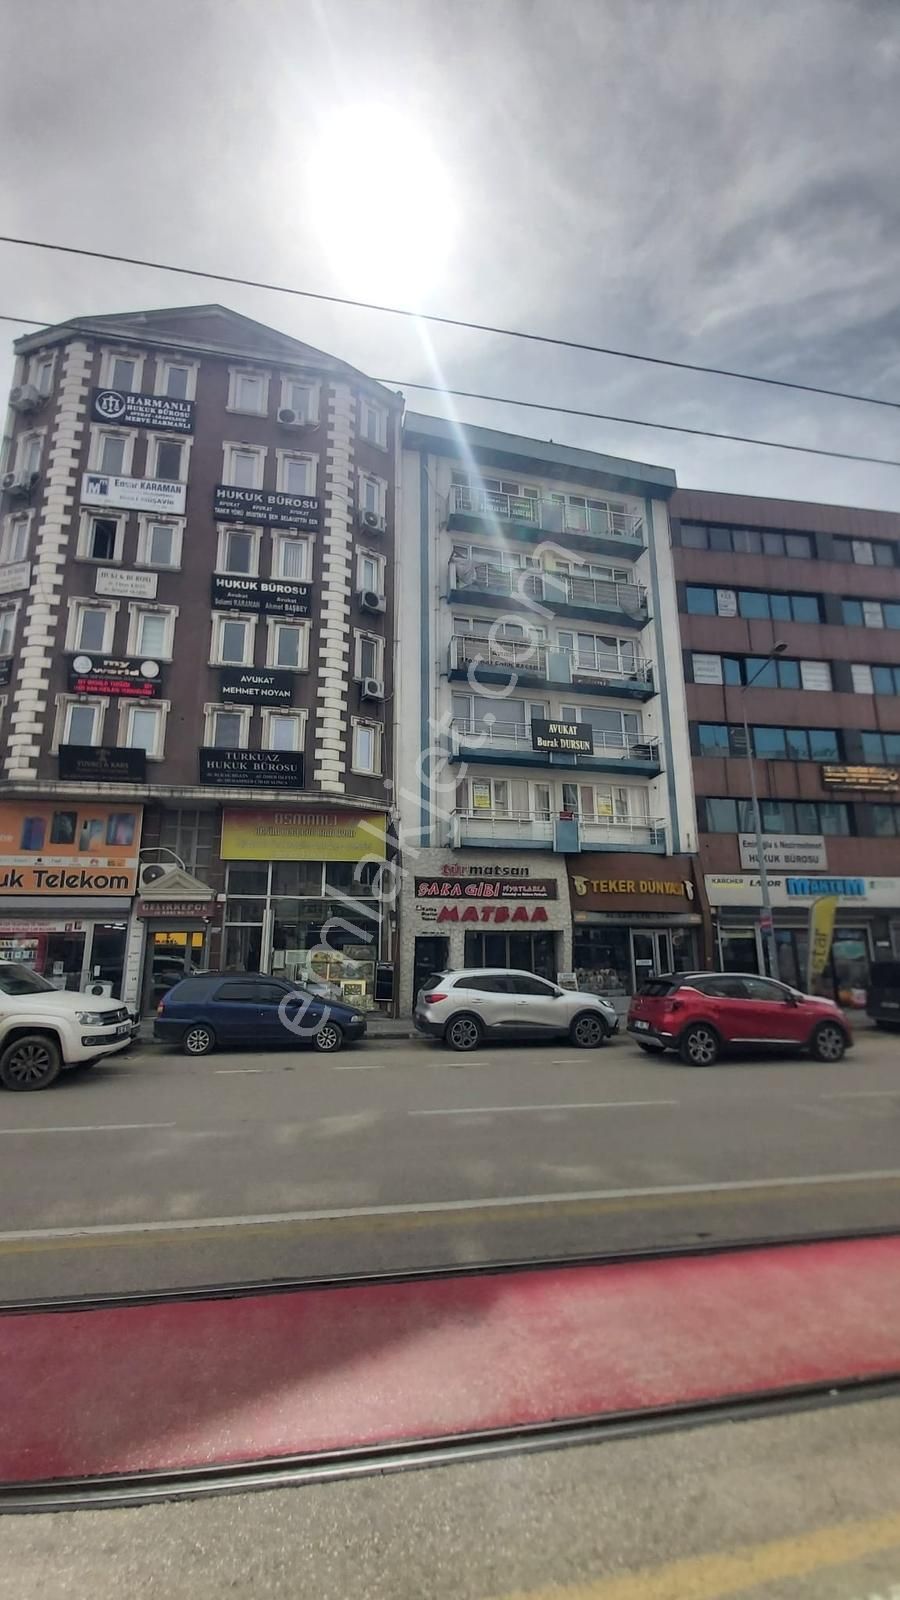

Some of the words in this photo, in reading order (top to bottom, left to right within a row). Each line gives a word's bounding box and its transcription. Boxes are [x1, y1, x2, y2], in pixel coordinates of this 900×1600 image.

[127, 396, 191, 412] HARMANLI
[127, 404, 156, 414] HUKUK
[157, 407, 190, 418] BÜROSU
[152, 419, 191, 429] HARMANLI
[140, 482, 181, 494] KARAMAN
[217, 489, 263, 502] HUKUK
[267, 495, 318, 510] BÜROSU
[216, 578, 258, 591] HUKUK
[260, 582, 307, 596] BÜROSU
[103, 660, 130, 669] my
[240, 675, 275, 685] AVUKAT
[222, 687, 260, 696] MEHMET
[260, 689, 291, 698] NOYAN
[548, 723, 578, 736] AVUKAT
[537, 736, 559, 748] Burak
[559, 738, 591, 751] DURSUN
[206, 760, 248, 771] HUKUK
[253, 762, 298, 773] BÜROSU
[32, 869, 129, 889] Telekom
[749, 879, 781, 887] LAOR
[590, 879, 636, 894] TEKER
[436, 904, 549, 924] MATBAA
